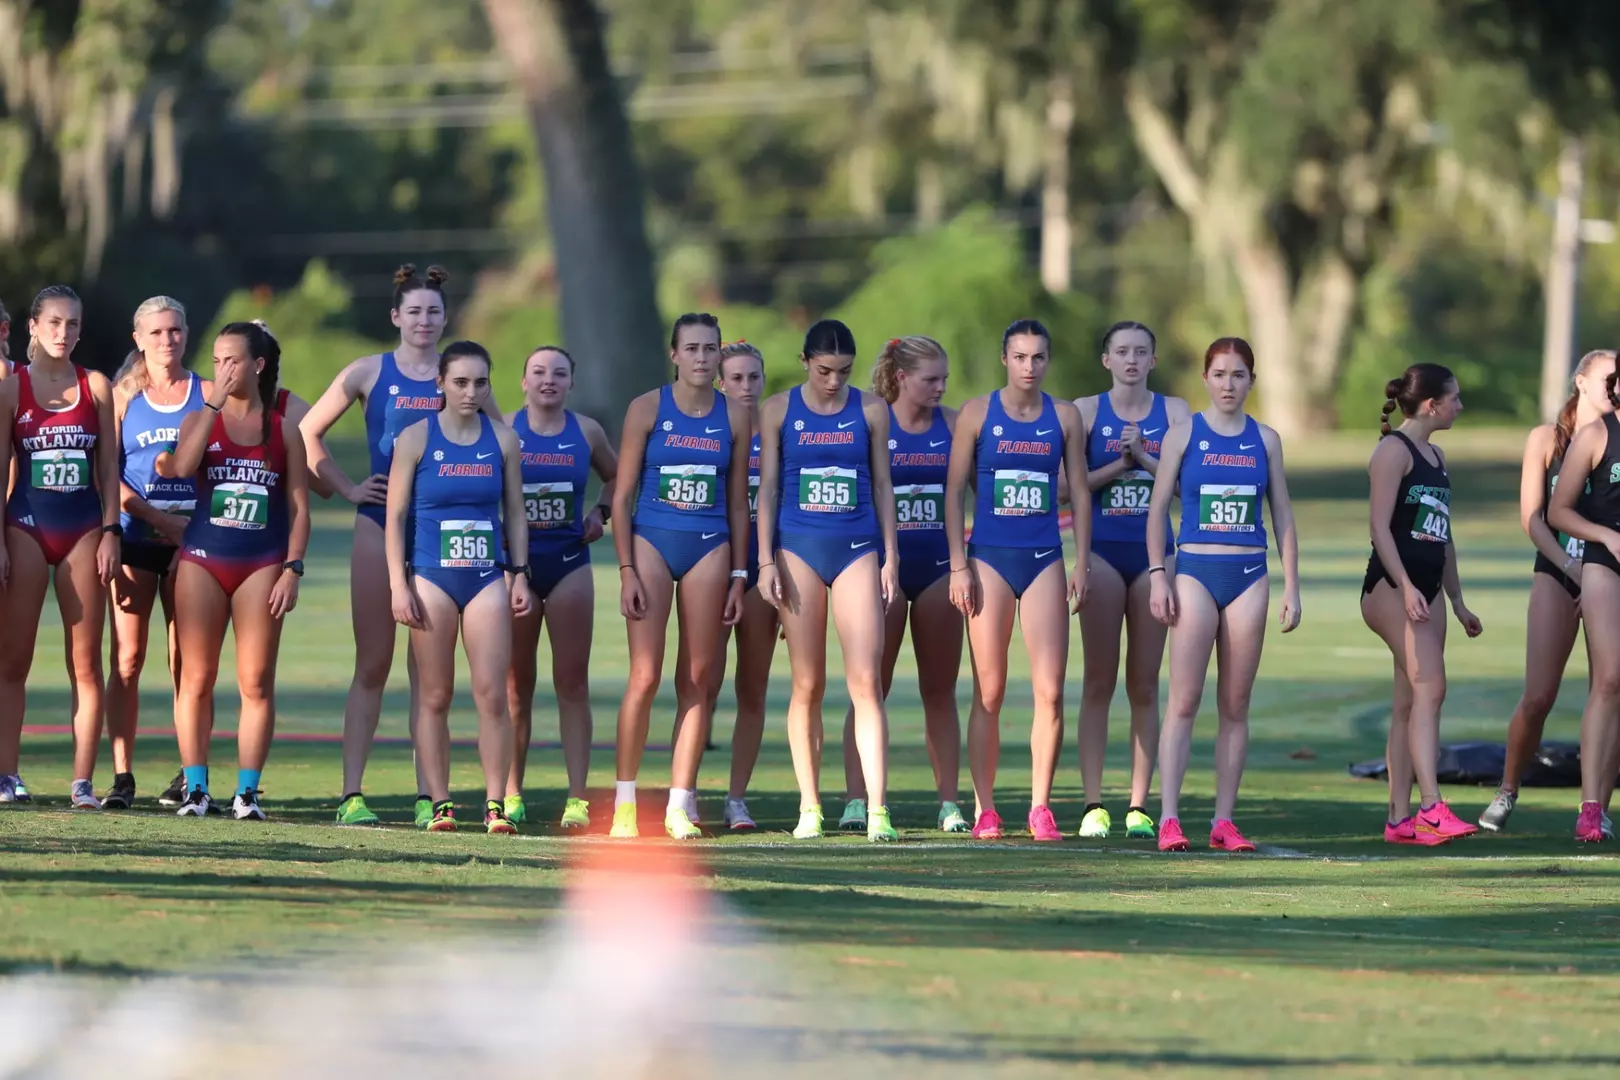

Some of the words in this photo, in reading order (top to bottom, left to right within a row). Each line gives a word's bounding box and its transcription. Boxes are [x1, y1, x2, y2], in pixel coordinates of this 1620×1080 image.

[39, 425, 84, 435] FLORIDA
[136, 427, 180, 448] FLORI
[798, 431, 854, 445] FLORIDA
[23, 434, 97, 450] ATLANTIC
[664, 434, 721, 452] FLORIDA
[996, 440, 1051, 455] FLORIDA
[1105, 439, 1160, 453] FLDA
[225, 458, 266, 469] FLORIDA
[891, 453, 947, 466] FLORIDA
[1202, 453, 1256, 468] FLORIDA
[42, 463, 80, 486] 373
[207, 466, 280, 486] ATLANTIC
[438, 463, 493, 477] FLORIDA
[144, 484, 172, 493] TRACK
[667, 478, 708, 503] 358
[808, 481, 850, 505] 355
[1003, 485, 1042, 509] 348
[1110, 485, 1151, 508] 352
[223, 497, 259, 521] 377
[525, 498, 566, 521] 353
[897, 499, 937, 522] 349
[1210, 501, 1248, 524] 357
[1422, 512, 1448, 540] 442
[449, 536, 488, 559] 356
